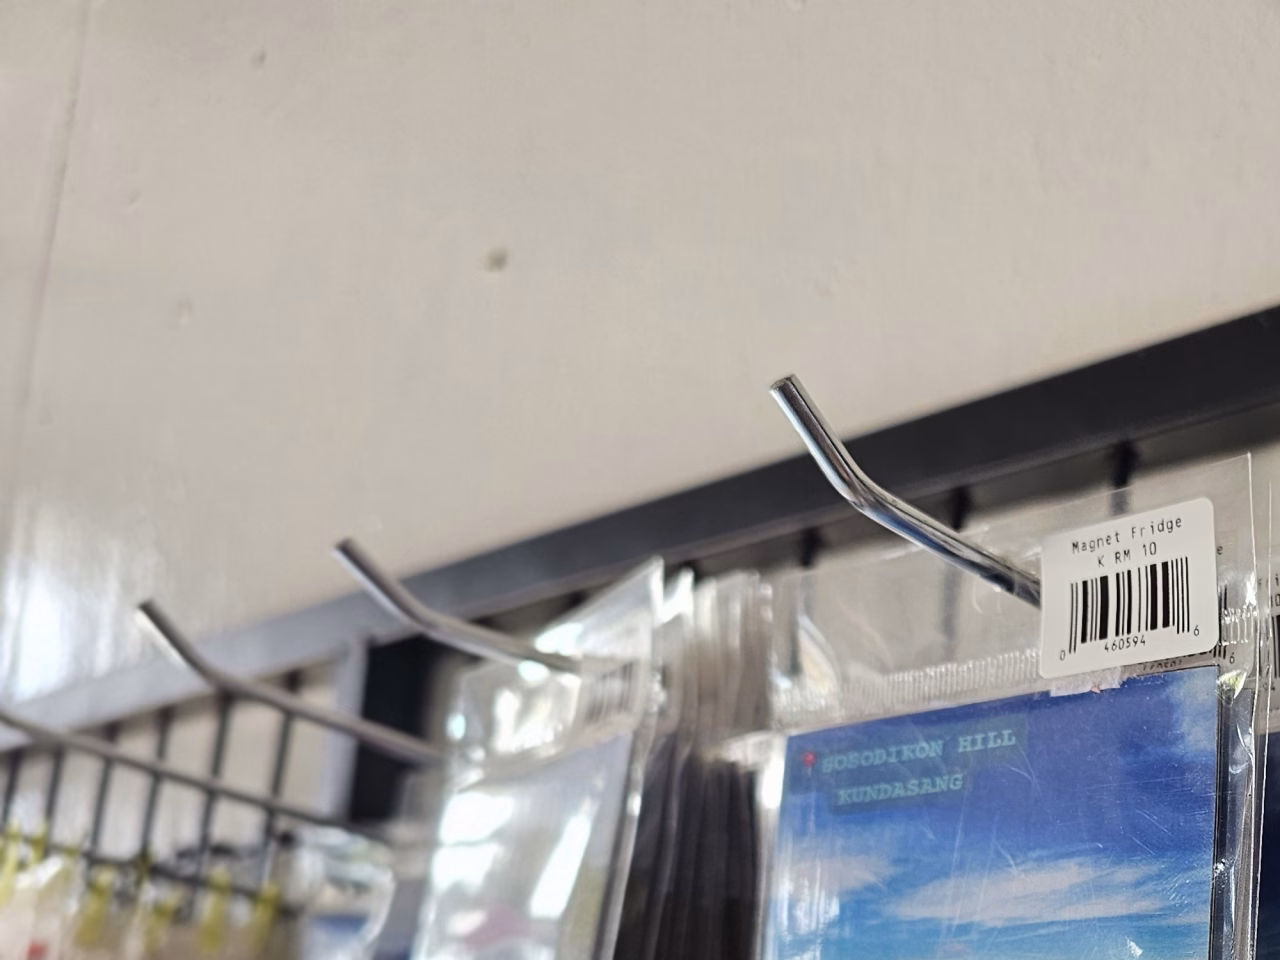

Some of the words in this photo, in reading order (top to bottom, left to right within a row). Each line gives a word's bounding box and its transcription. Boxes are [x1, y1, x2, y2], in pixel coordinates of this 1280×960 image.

[1071, 531, 1121, 555] Magnet
[1131, 515, 1183, 540] Fridge
[1096, 554, 1106, 568] K
[1114, 549, 1132, 564] RM
[1141, 541, 1158, 557] 10
[1058, 648, 1067, 662] 0
[1103, 634, 1147, 654] 460594
[1193, 624, 1201, 637] 6
[958, 729, 1016, 753] HILL
[838, 775, 963, 805] KUNDASANG
